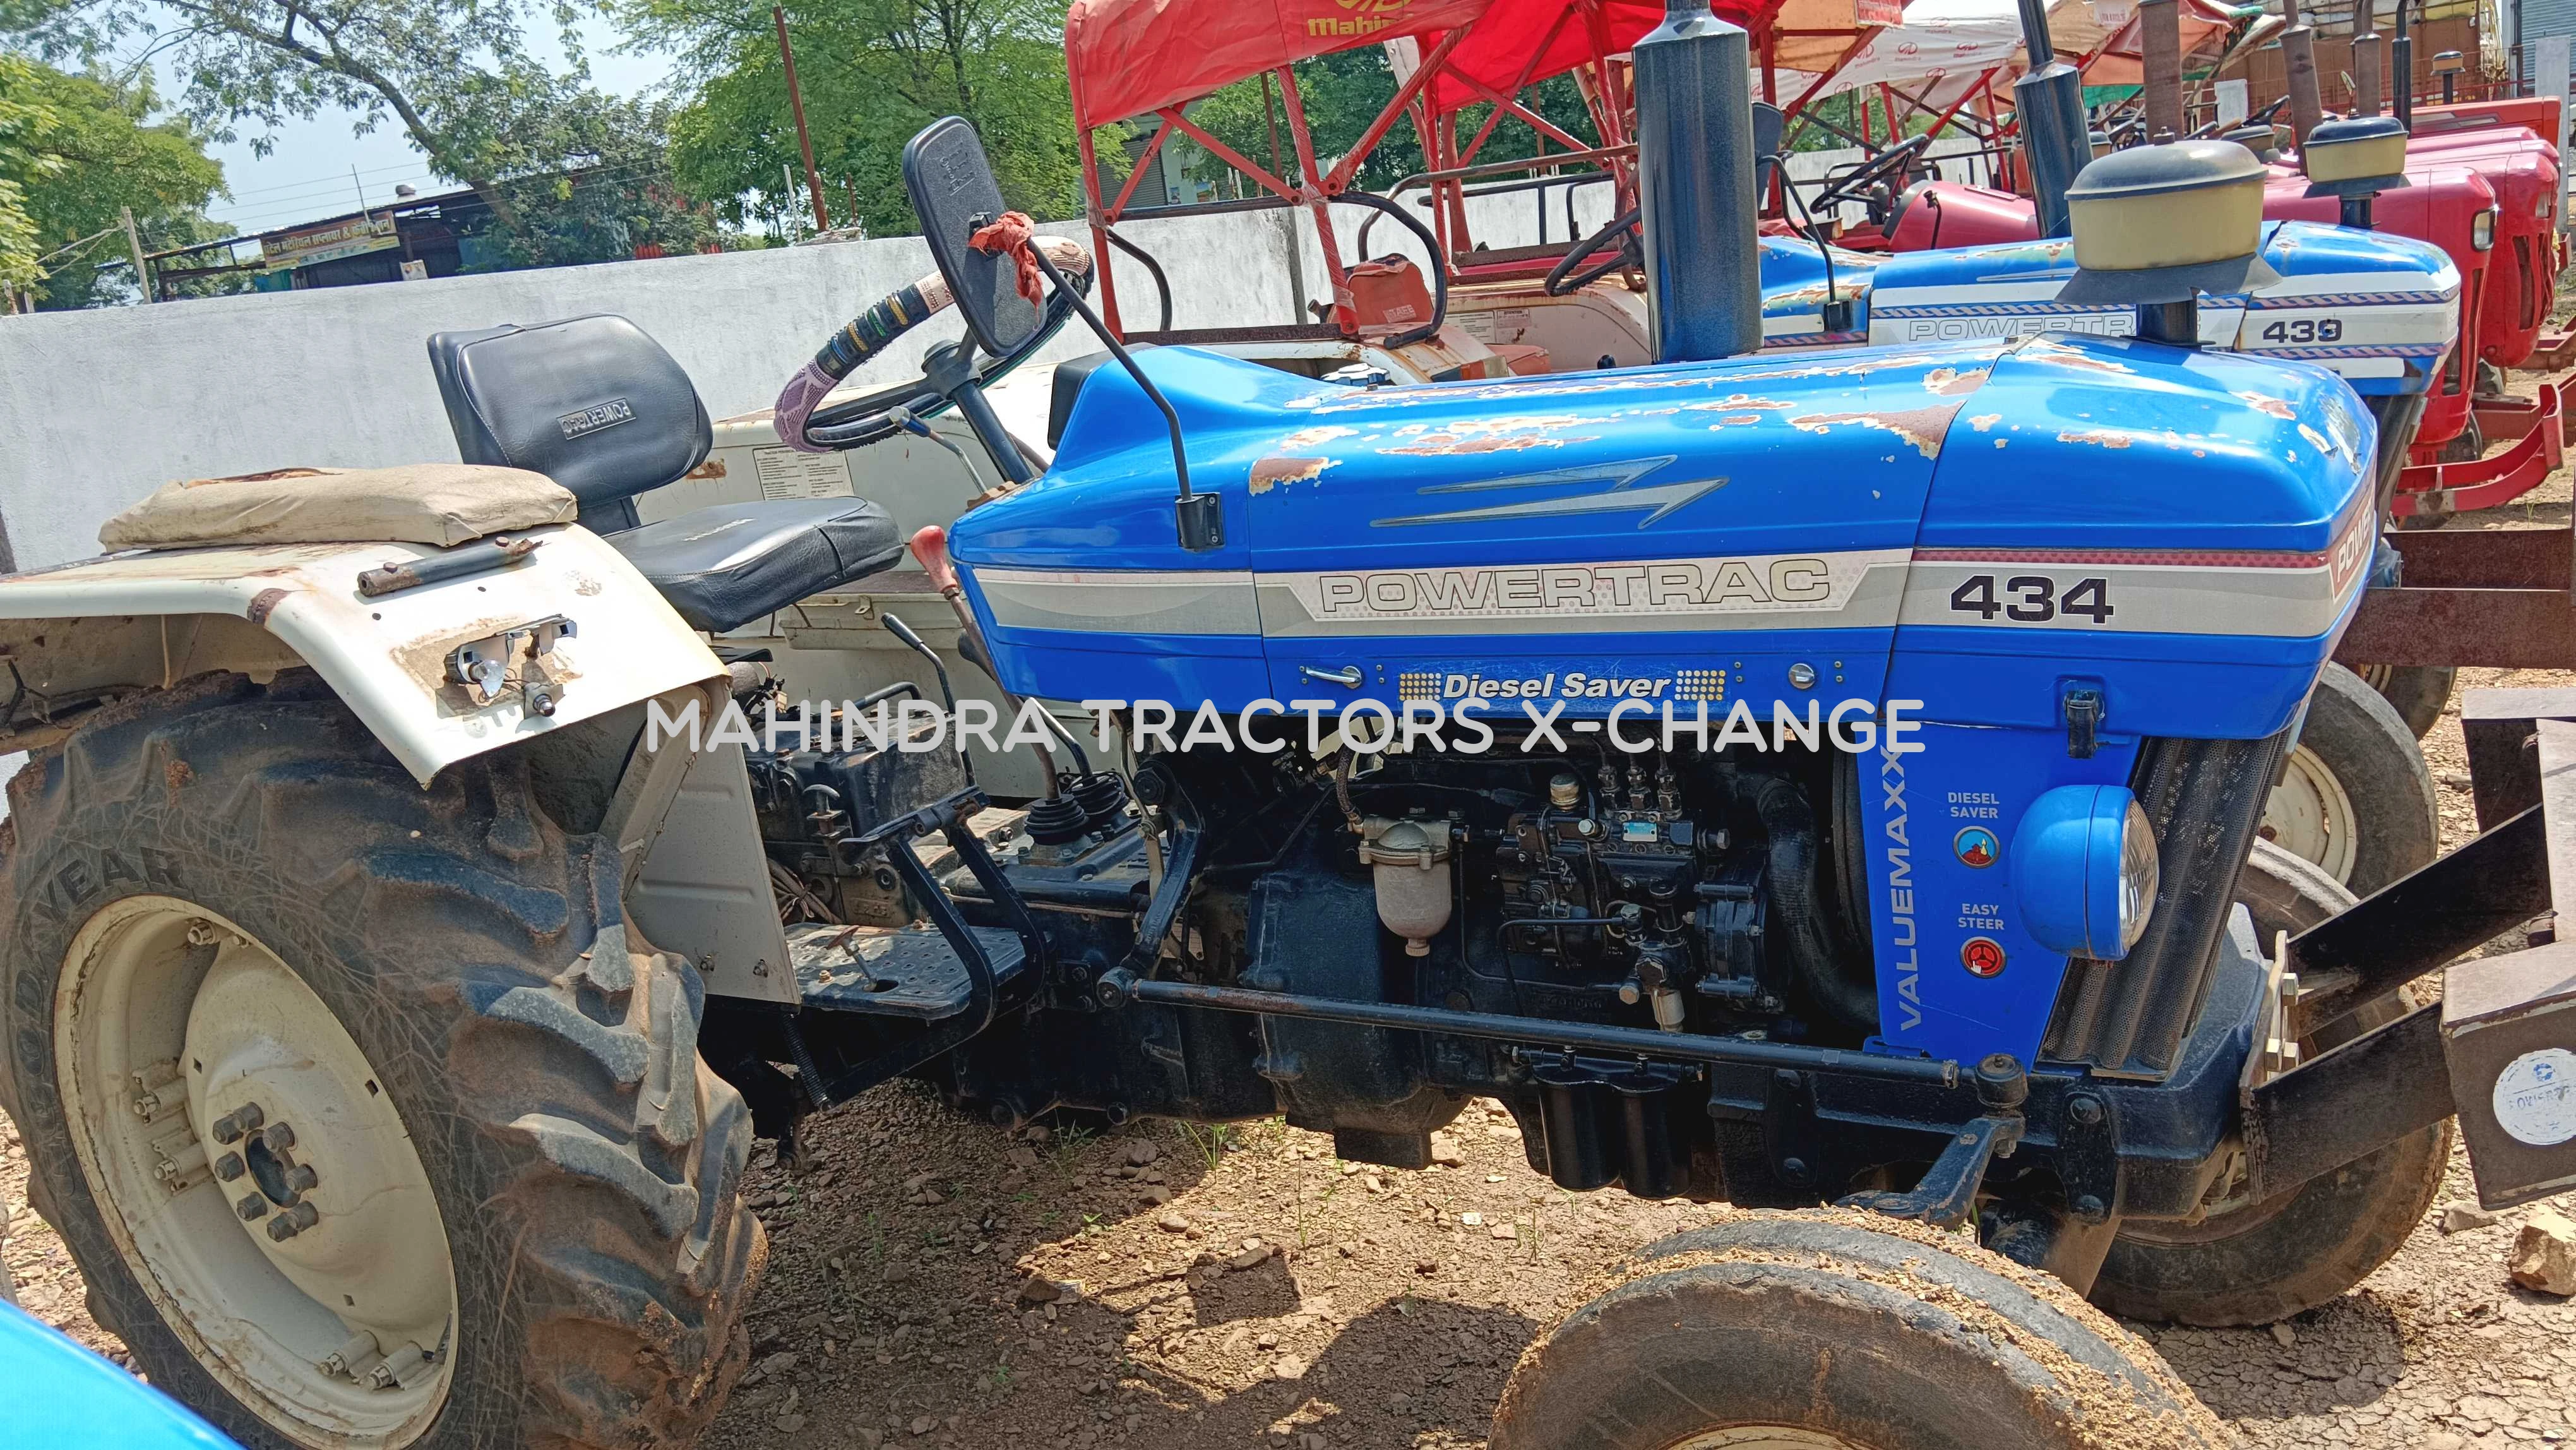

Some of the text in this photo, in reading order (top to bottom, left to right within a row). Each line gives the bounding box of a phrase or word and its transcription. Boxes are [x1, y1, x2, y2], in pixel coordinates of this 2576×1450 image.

[1308, 15, 1396, 36] Mahi
[342, 226, 352, 239] &
[2263, 319, 2342, 344] 439
[1319, 558, 1832, 613] POWERTRAC
[1950, 574, 2115, 625] 434
[1443, 672, 1672, 698] Diesel Saver
[1948, 792, 2000, 805] DIESEL
[1950, 806, 1999, 819] SAVER
[1880, 744, 1921, 1031] VALUEMAXX
[1962, 903, 1999, 916] EASY
[1958, 917, 2005, 930] STEER
